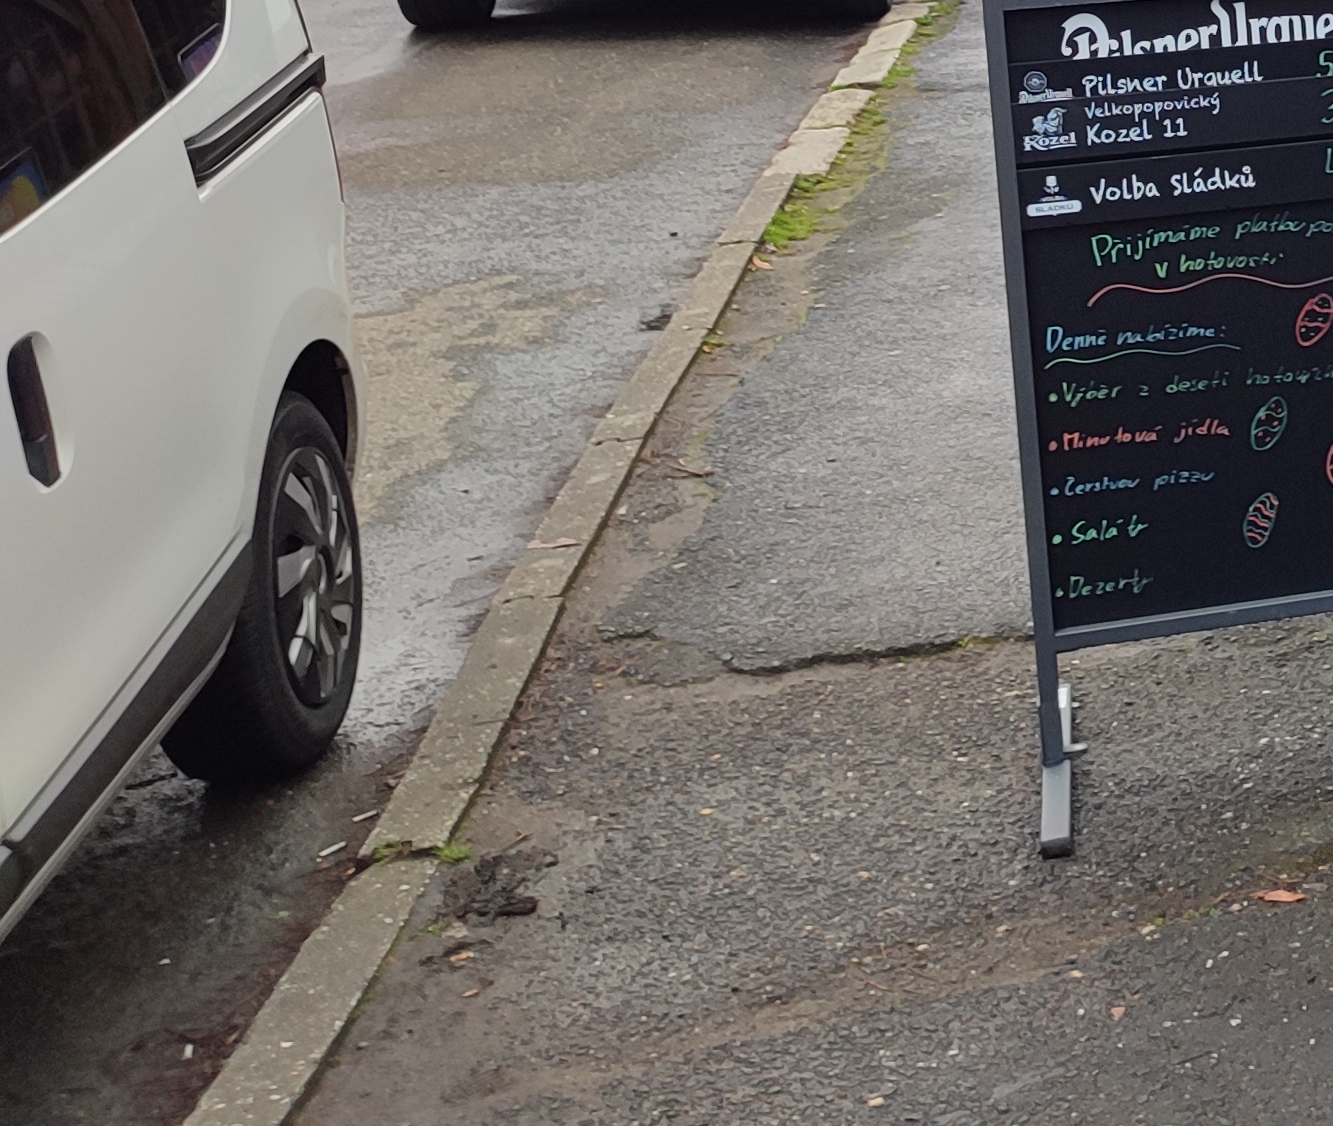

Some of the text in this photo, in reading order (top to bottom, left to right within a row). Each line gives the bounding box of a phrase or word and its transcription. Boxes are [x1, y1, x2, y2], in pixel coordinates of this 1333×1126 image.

[1082, 73, 1167, 97] Pilsner
[1084, 92, 1220, 122] Velkopopovický
[1023, 132, 1078, 151] Kozel
[1086, 117, 1188, 146] Kozel 11
[1089, 173, 1160, 205] Volba
